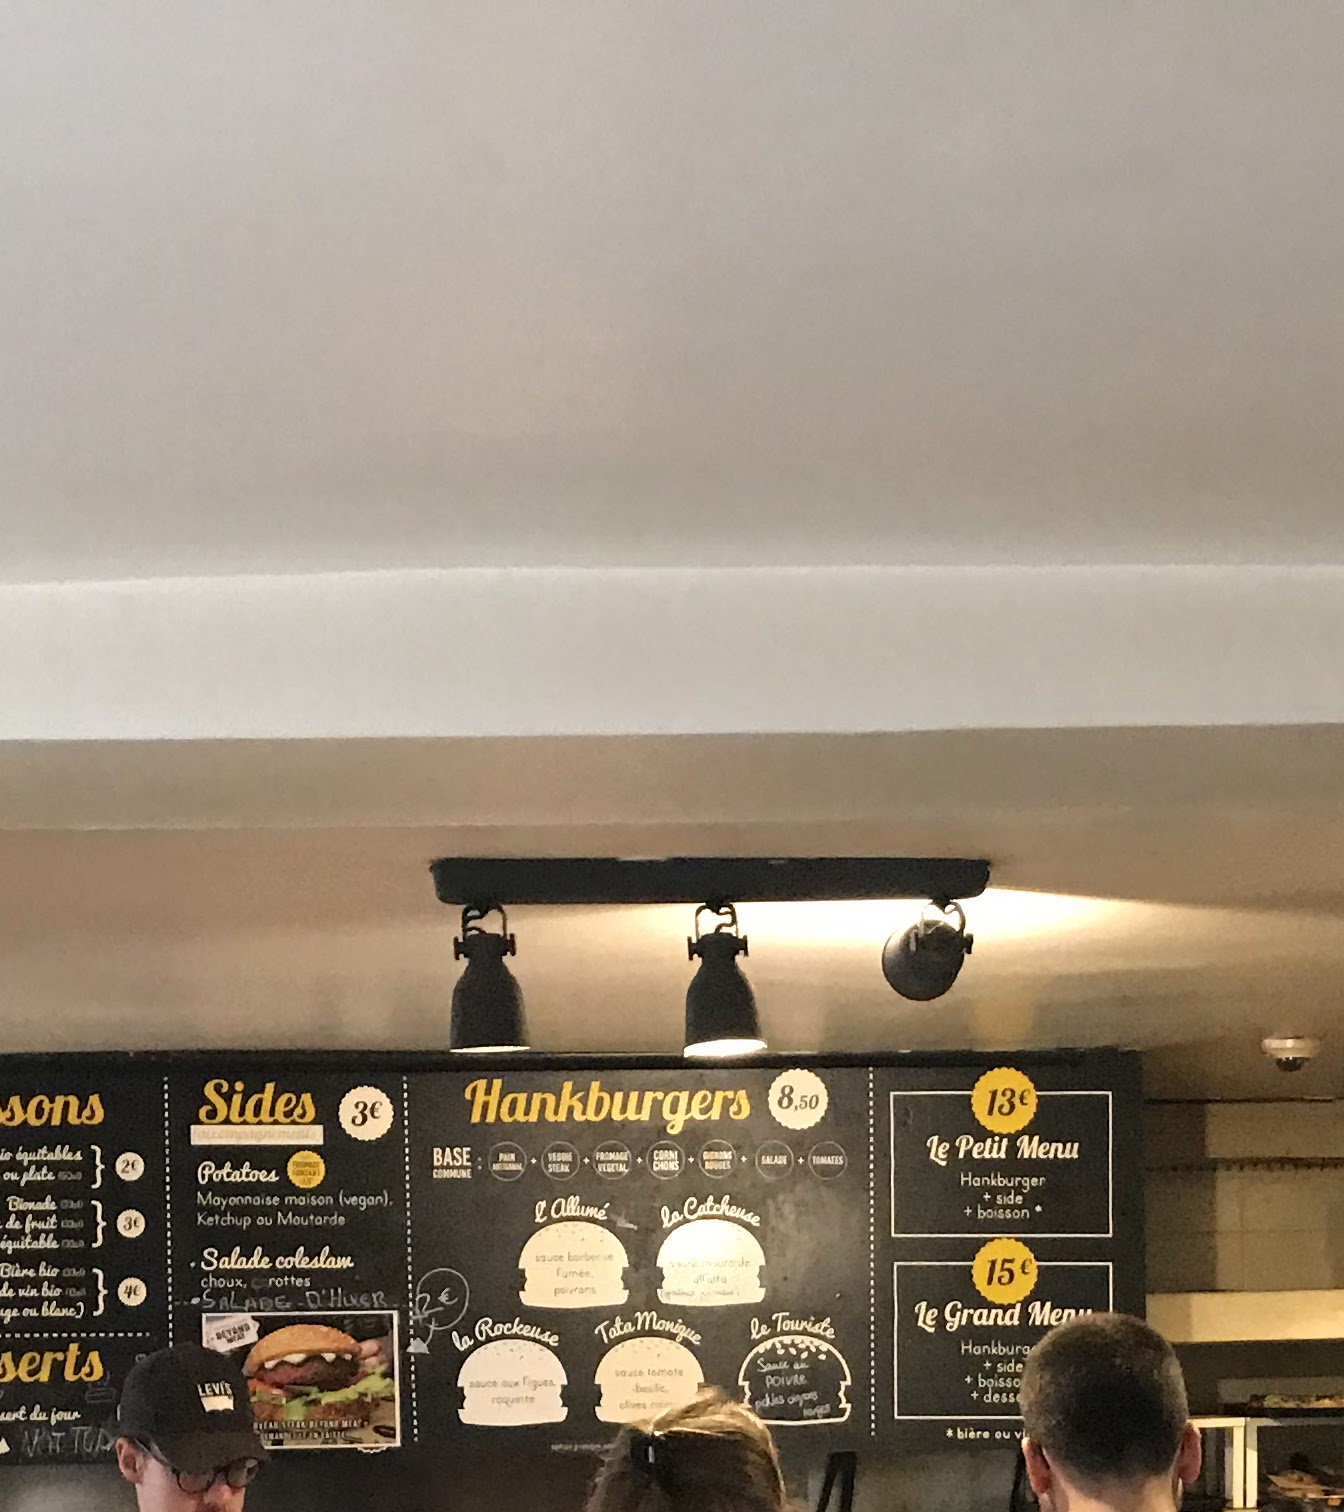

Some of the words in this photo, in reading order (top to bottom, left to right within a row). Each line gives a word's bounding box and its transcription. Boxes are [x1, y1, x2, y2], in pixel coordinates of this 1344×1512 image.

[199, 1079, 316, 1124] Sides
[464, 1078, 752, 1135] Hankburgers
[777, 1084, 820, 1111] 8,50
[986, 1087, 1031, 1117] 13€
[351, 1101, 383, 1126] 3€
[16, 1145, 83, 1166] équitables
[433, 1147, 472, 1167] BASE
[812, 1155, 844, 1165] TOMATES
[926, 1135, 950, 1166] Le
[955, 1134, 1009, 1160] Petit
[1016, 1135, 1080, 1160] Menu
[3, 1170, 20, 1181] ou
[20, 1165, 55, 1187] plate
[121, 1158, 140, 1174] 2€
[198, 1161, 280, 1185] Potatoes
[432, 1168, 472, 1179] COMMUNE
[547, 1163, 570, 1173] STEAK
[960, 1172, 1046, 1193] Hankburger
[6, 1194, 57, 1211] Bionade
[197, 1191, 280, 1210] Mayonnaise
[284, 1193, 334, 1206] maison
[996, 1193, 1023, 1205] side
[197, 1212, 252, 1230] Ketchup
[256, 1216, 272, 1226] ou
[277, 1211, 346, 1226] Moutarde
[661, 1204, 684, 1229] la
[683, 1194, 761, 1227] Catcheuse
[977, 1206, 1030, 1219] boisson
[6, 1214, 22, 1229] de
[25, 1214, 58, 1234] fruit
[0, 1233, 60, 1254] équitable
[200, 1245, 272, 1270] Salade
[275, 1245, 354, 1269] coleslaw
[39, 1262, 60, 1277] bio
[986, 1258, 1033, 1286] 15€
[0, 1281, 16, 1297] de
[18, 1285, 39, 1297] vin
[41, 1281, 62, 1297] bio
[200, 1273, 247, 1289] choux,
[22, 1307, 39, 1317] ou
[41, 1301, 85, 1320] blanc)
[914, 1301, 938, 1332] Le
[944, 1301, 1020, 1331] Grand
[452, 1331, 474, 1351] la
[474, 1317, 560, 1347] Rockeuse
[595, 1316, 635, 1344] Tata
[634, 1310, 702, 1346] Monique
[751, 1317, 771, 1339] le
[771, 1312, 836, 1339] Touriste
[961, 1339, 1031, 1355] Hankburg
[997, 1359, 1023, 1373] side
[978, 1373, 1021, 1388] boisso
[983, 1387, 1019, 1403] dess
[29, 1404, 48, 1421] du
[50, 1408, 81, 1426] jour
[957, 1427, 990, 1439] bière
[995, 1430, 1011, 1439] ou
[1014, 1429, 1027, 1439] vi
